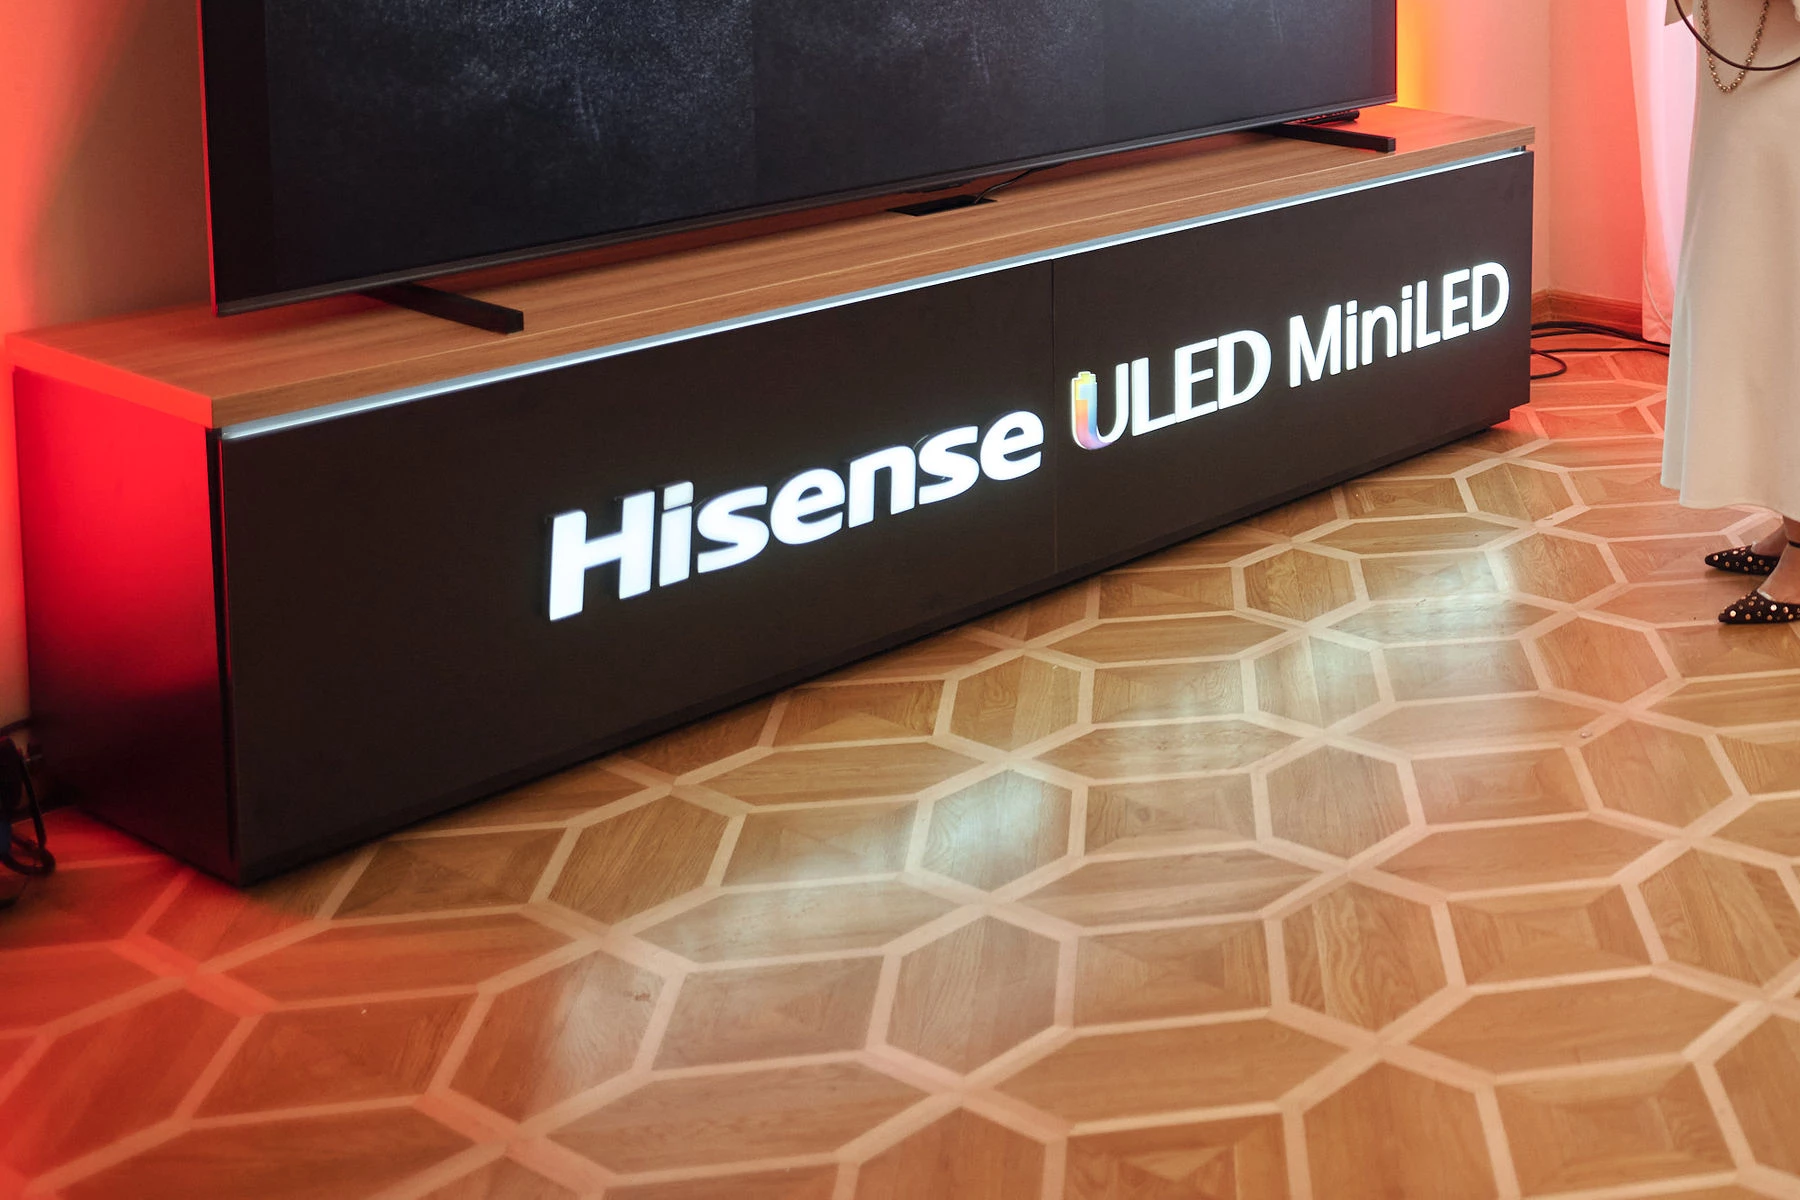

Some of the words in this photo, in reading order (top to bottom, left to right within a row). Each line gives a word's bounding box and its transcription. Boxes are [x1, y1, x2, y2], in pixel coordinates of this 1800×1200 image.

[548, 409, 1043, 620] Hisense
[1071, 329, 1272, 450] ULED
[1288, 262, 1509, 387] MiniLED
